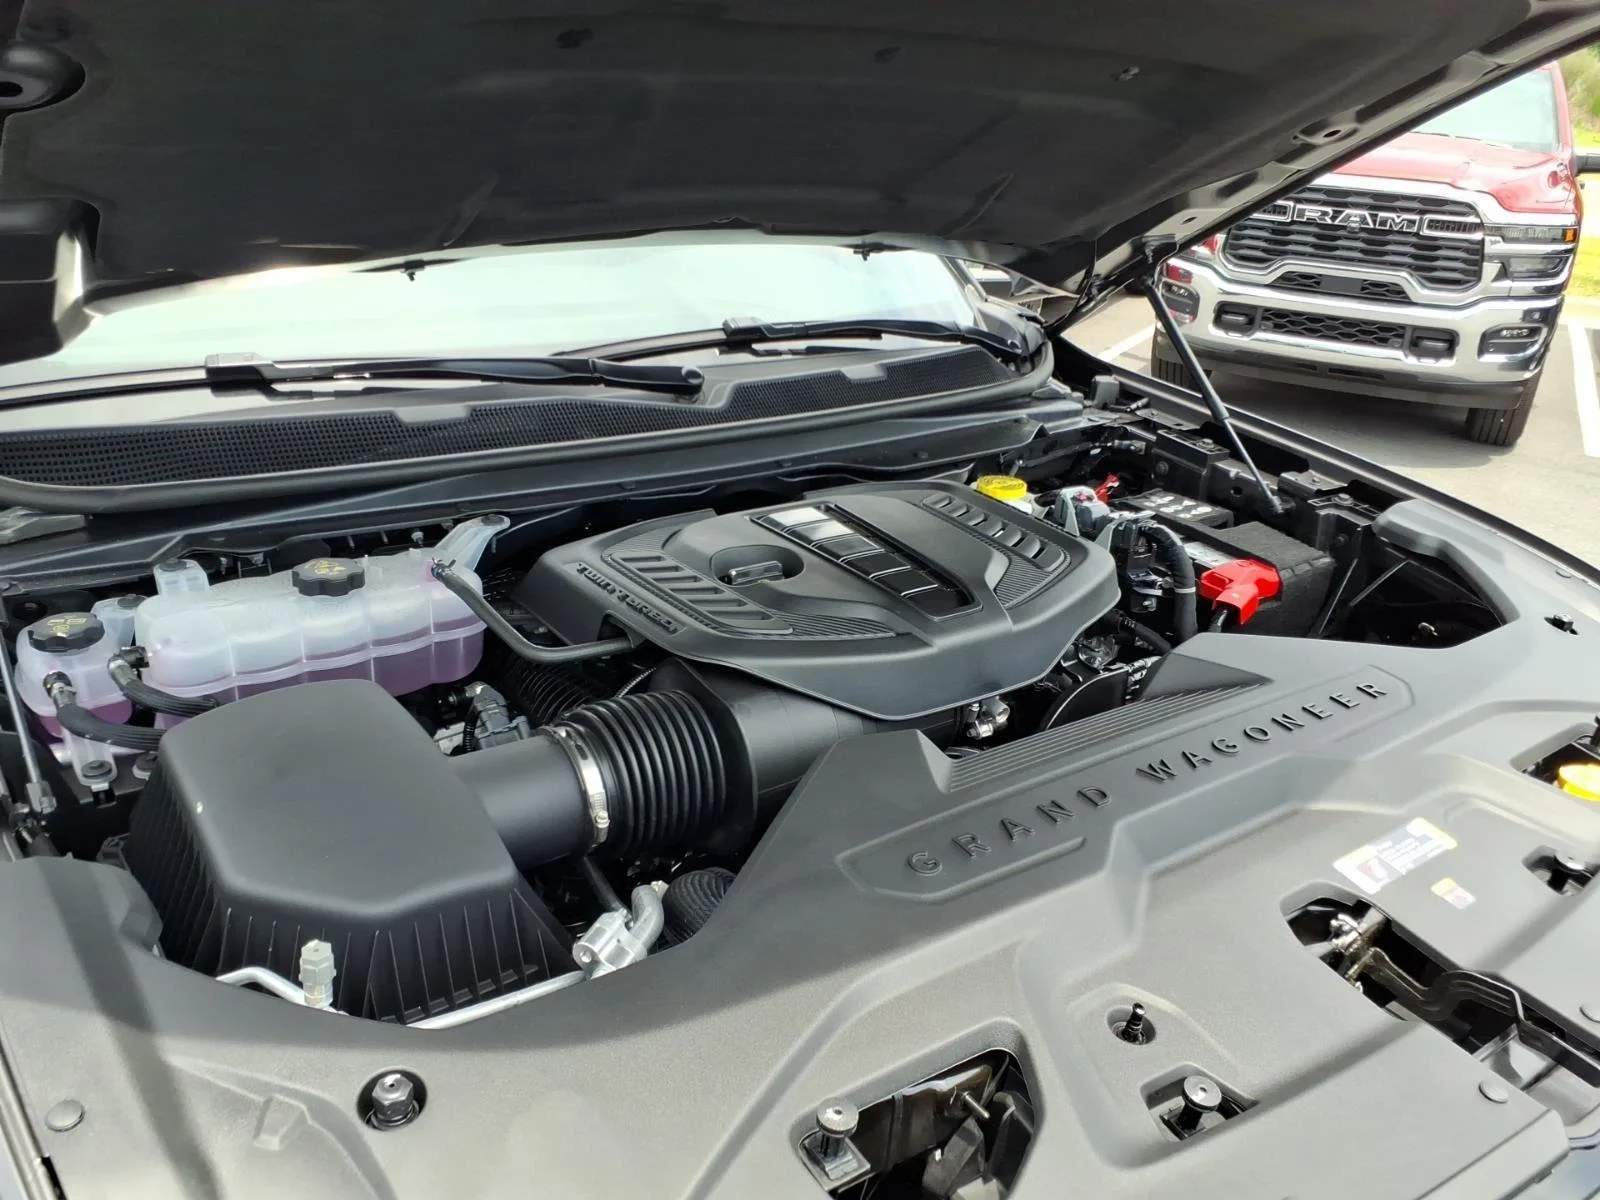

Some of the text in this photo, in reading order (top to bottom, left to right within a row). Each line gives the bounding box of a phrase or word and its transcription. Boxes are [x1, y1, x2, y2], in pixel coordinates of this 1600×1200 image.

[1294, 203, 1421, 232] RAM
[617, 589, 678, 633] TURBO
[907, 681, 1387, 876] GRAND WAGONEER
